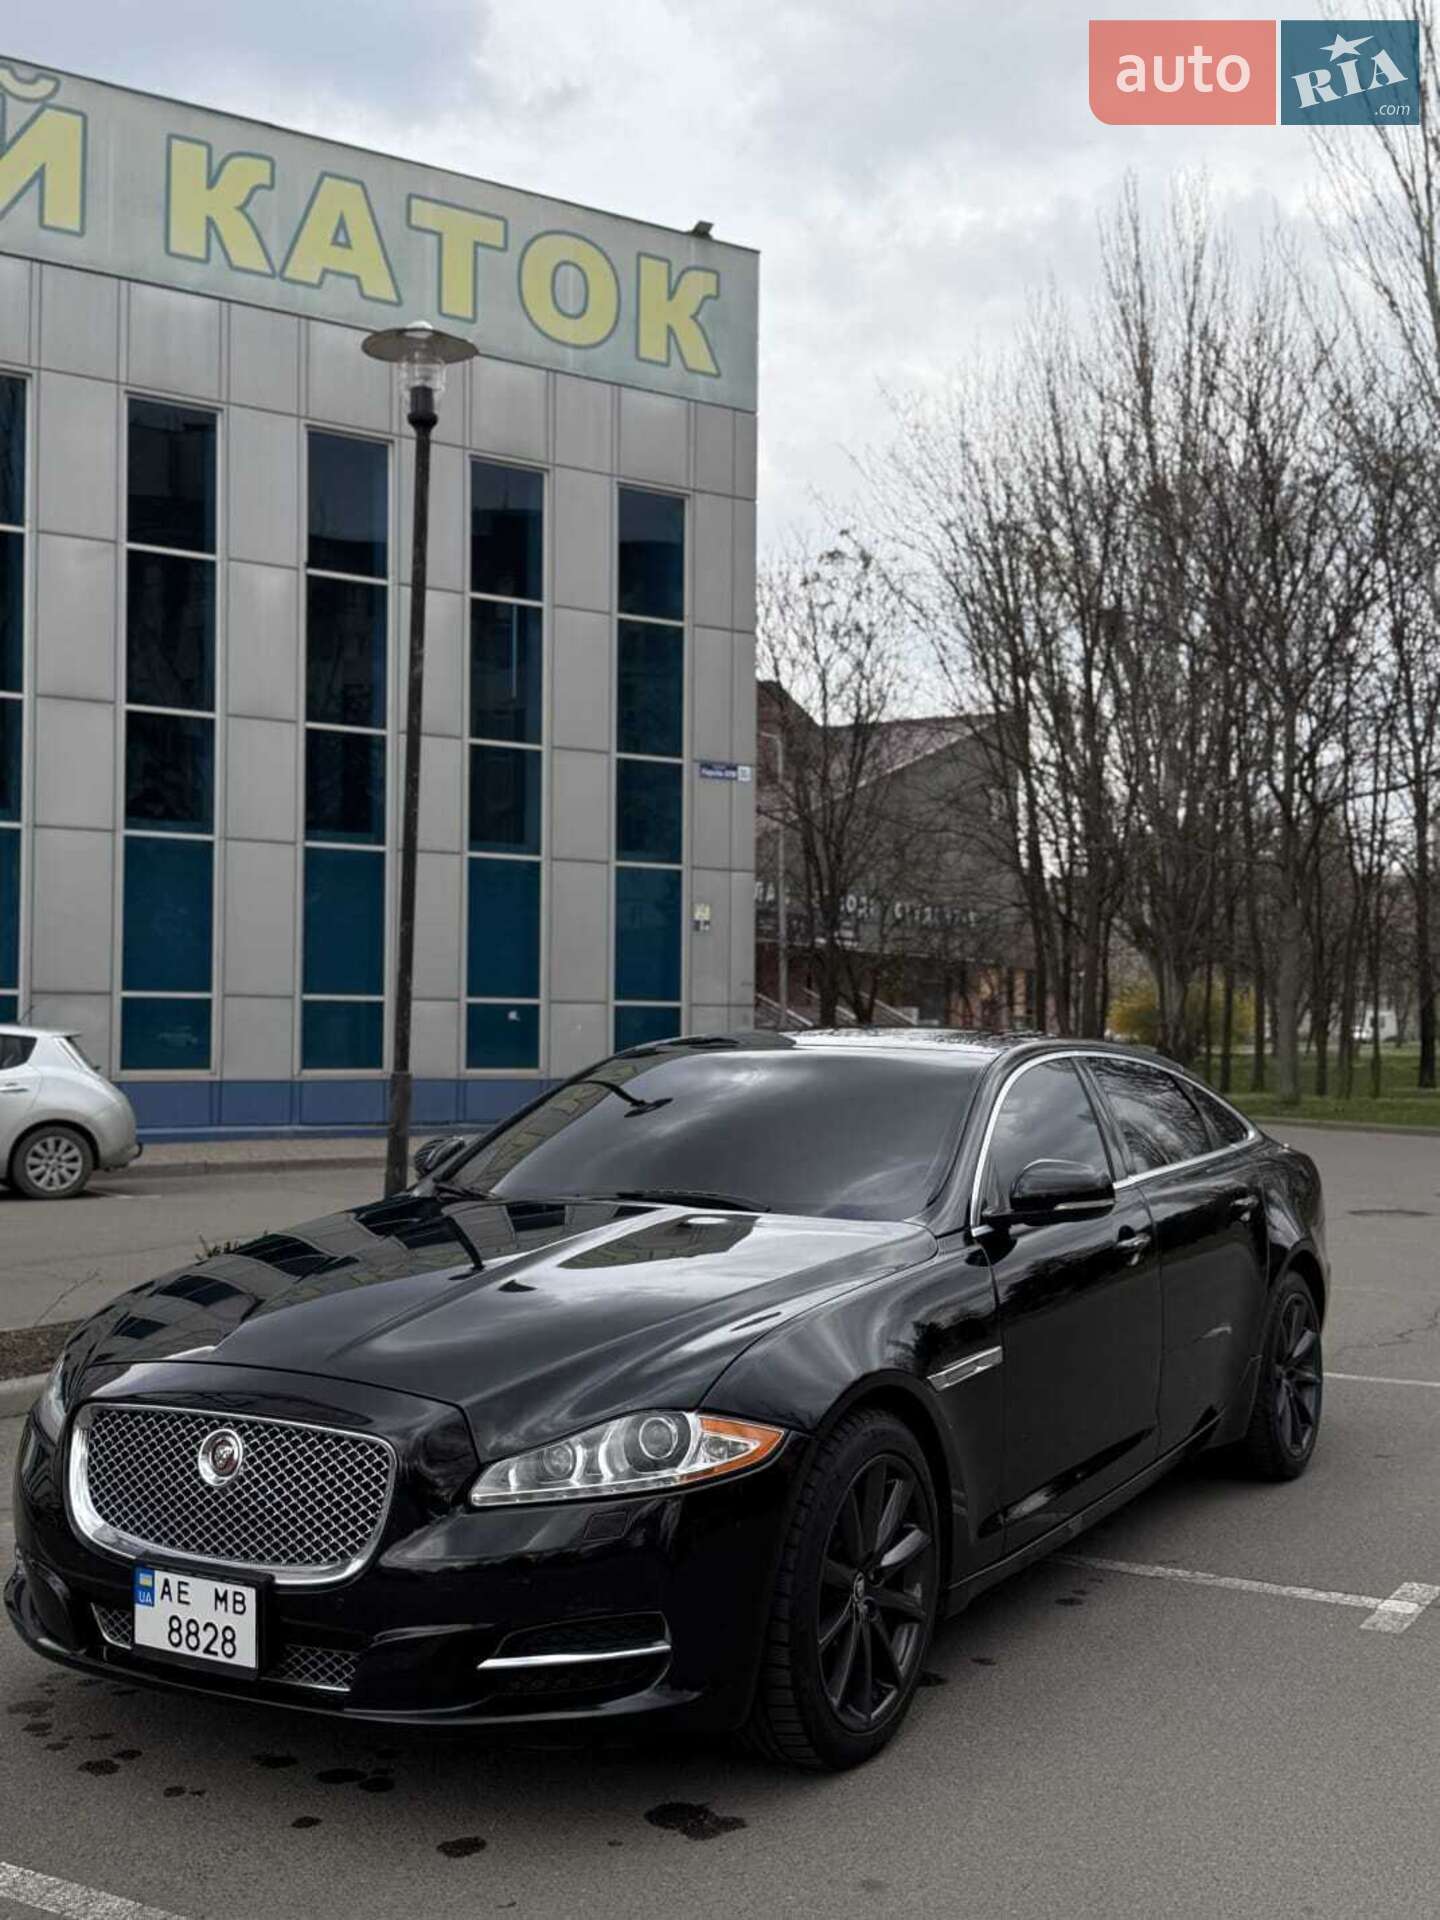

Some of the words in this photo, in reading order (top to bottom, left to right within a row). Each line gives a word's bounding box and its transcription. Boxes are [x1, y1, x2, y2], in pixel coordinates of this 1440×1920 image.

[165, 133, 722, 377] КАТОК
[138, 1590, 153, 1604] UA
[160, 1577, 191, 1605] AE
[214, 1587, 247, 1616] MB
[168, 1615, 236, 1658] 8828
